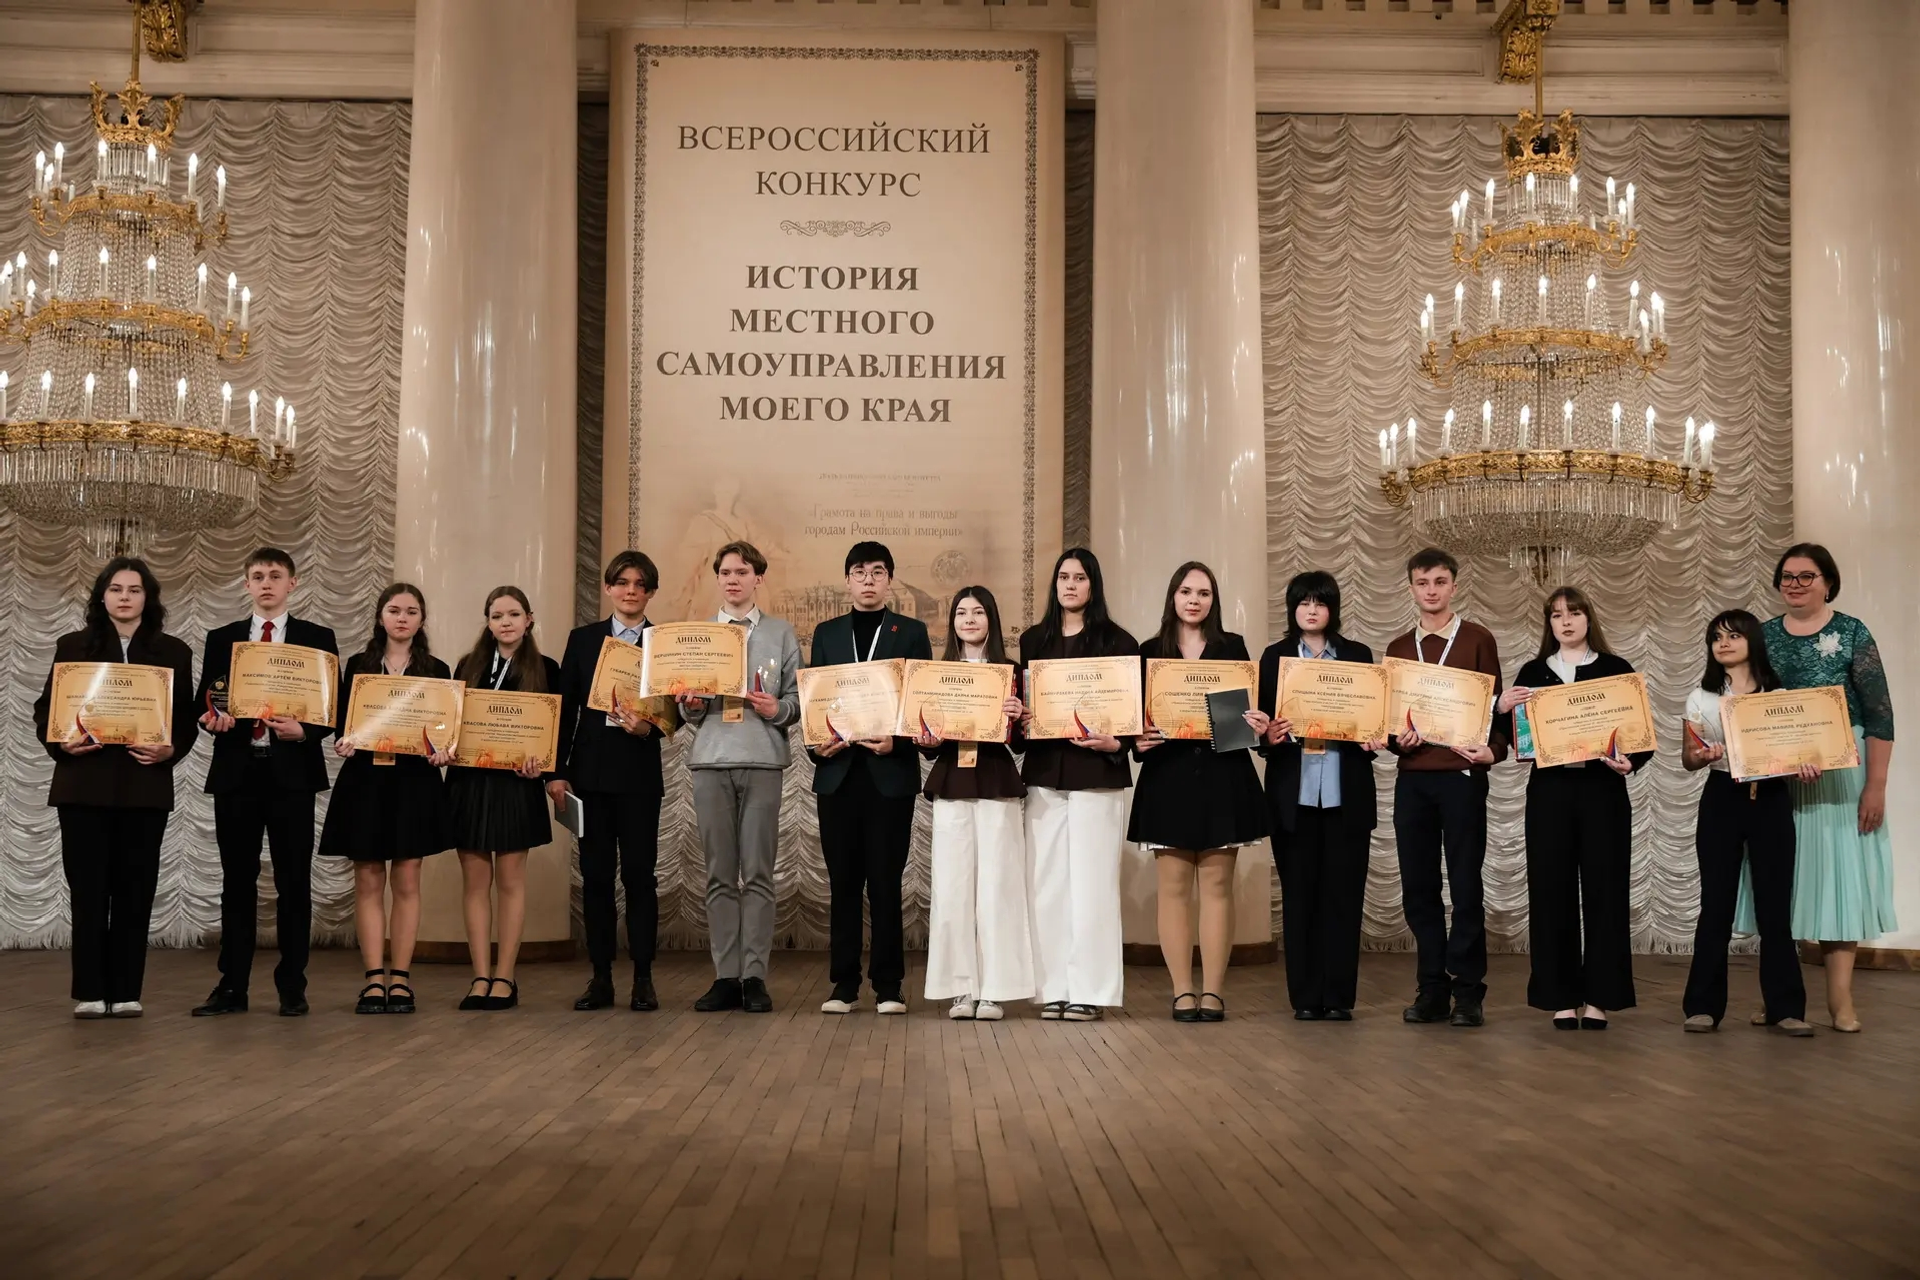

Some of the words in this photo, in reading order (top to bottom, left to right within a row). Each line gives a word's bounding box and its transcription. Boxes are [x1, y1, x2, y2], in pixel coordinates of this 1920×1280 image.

[677, 121, 991, 153] ВСЕРОССИЙСКИЙ
[755, 170, 921, 198] КОНКУРС
[745, 264, 920, 292] ИСТОРИЯ
[729, 308, 935, 335] МЕСТНОГО
[656, 351, 1007, 380] САМОУПРАВЛЕНИЯ
[719, 395, 850, 422] МОЕГО
[860, 397, 952, 423] КРАЯ
[859, 510, 872, 518] на
[875, 508, 905, 522] права
[908, 510, 915, 518] и
[919, 509, 958, 520] выгоды
[804, 524, 846, 538] городам
[850, 520, 911, 537] Российской
[914, 526, 963, 539] империи»
[675, 636, 712, 645] ДИПЛОМ
[266, 657, 305, 669] ДИПЛОМ
[938, 676, 975, 685] ДИПЛОМ
[1066, 673, 1103, 682] ДИПЛОМ
[1183, 675, 1221, 683] ДИПЛОМ
[1316, 674, 1354, 685] ДИПЛОМ
[1417, 677, 1455, 690] ДИПЛОМ
[387, 689, 426, 700] ДИПЛОМ
[1566, 692, 1607, 706] ДИПЛОМ
[486, 705, 523, 715] ДИПЛОМ
[1763, 704, 1805, 717] ДИПЛОМ
[1545, 714, 1579, 725] КОРЧАГИНА
